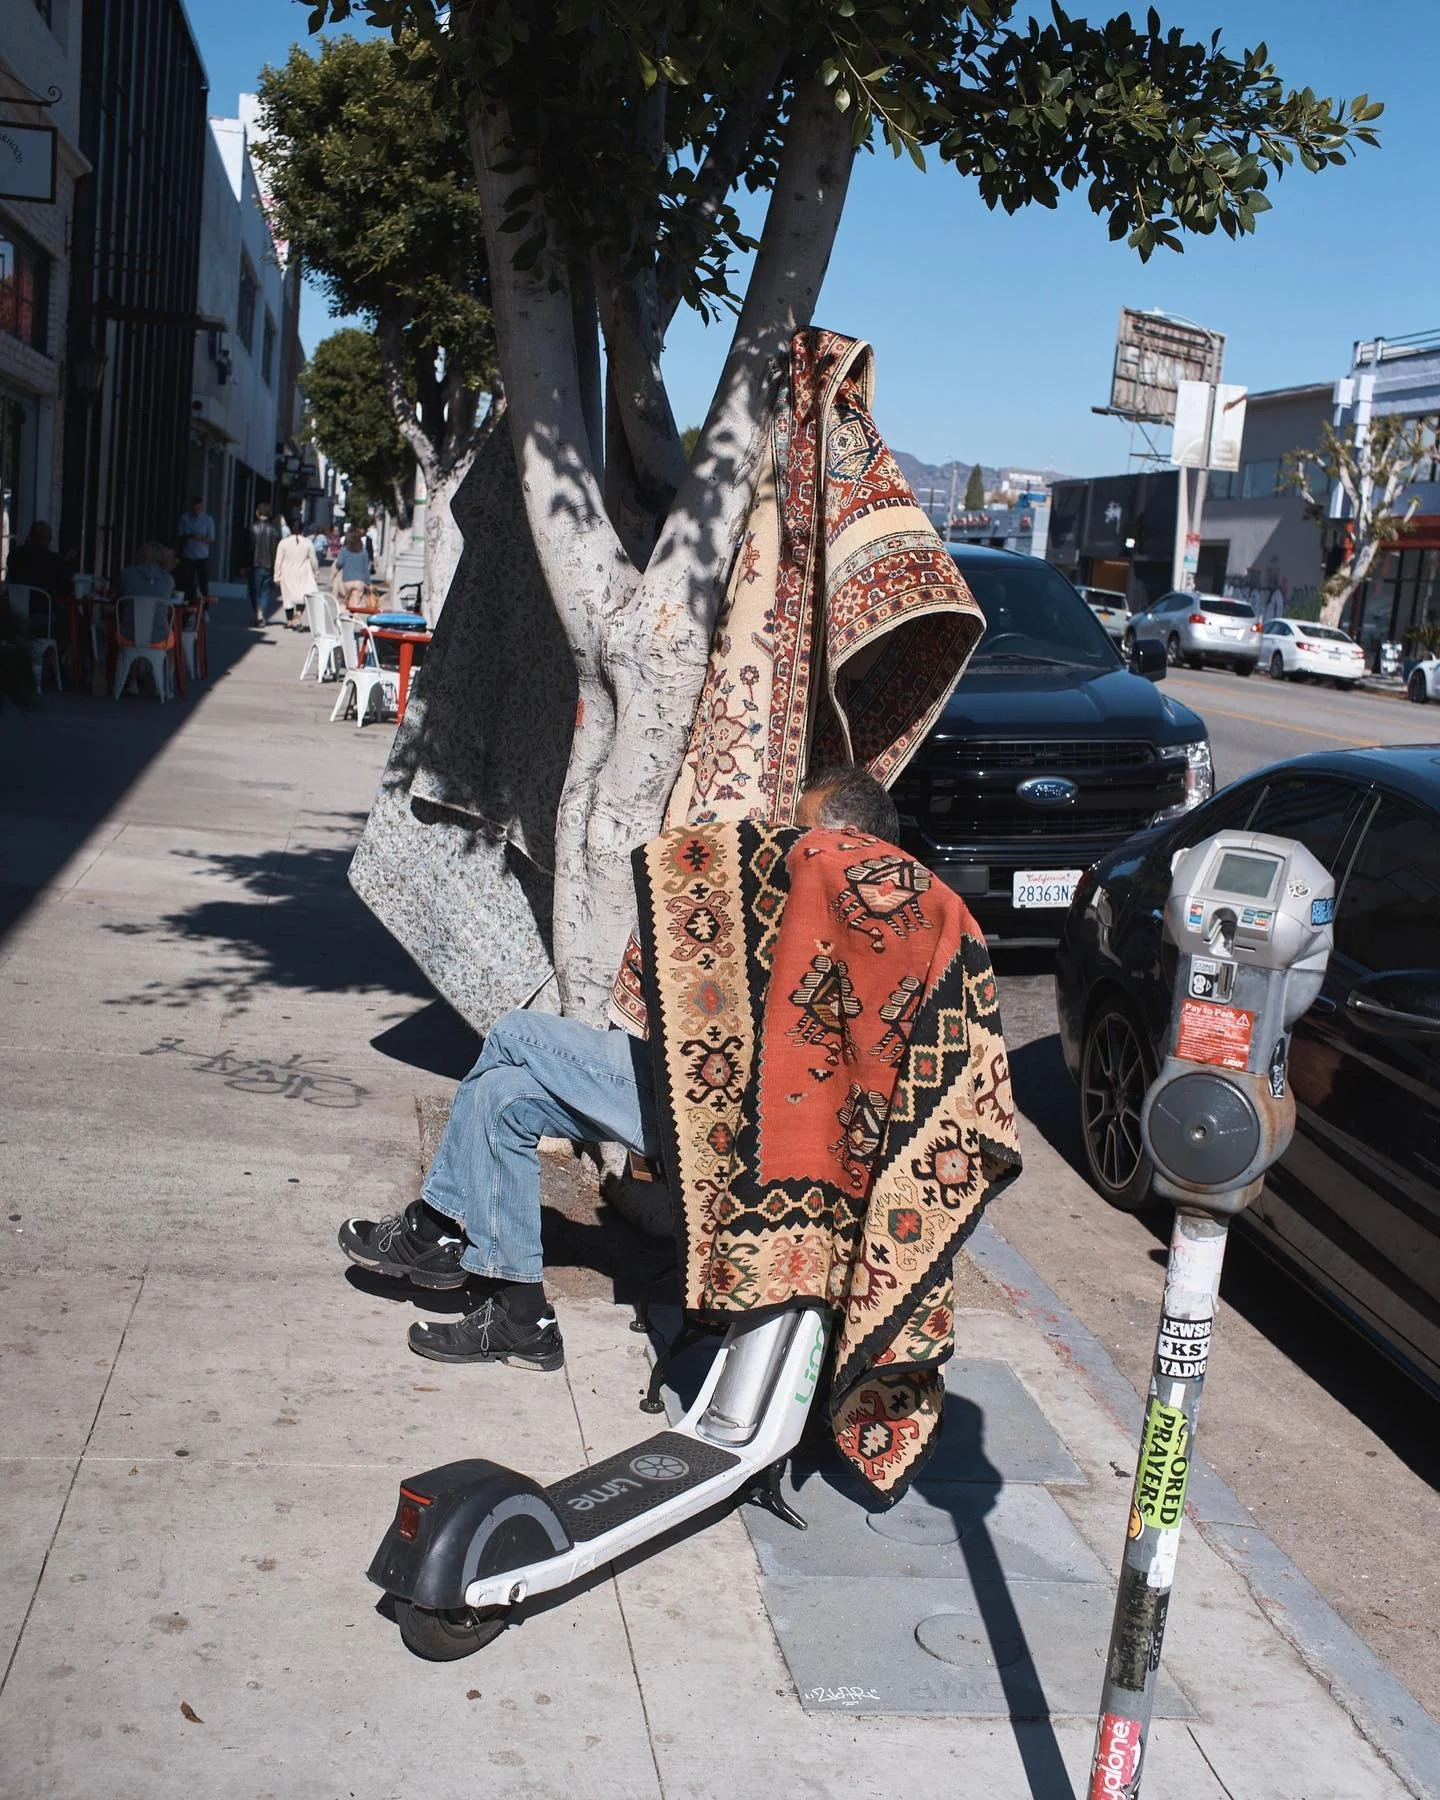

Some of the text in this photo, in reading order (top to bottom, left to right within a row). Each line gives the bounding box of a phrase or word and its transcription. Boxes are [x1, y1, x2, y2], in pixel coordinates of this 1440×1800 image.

[1028, 874, 1066, 884] California
[1184, 1003, 1236, 1019] Pay to Park
[794, 1322, 829, 1406] Lim
[1138, 1412, 1176, 1517] PRAYERS
[567, 1478, 643, 1511] Lime
